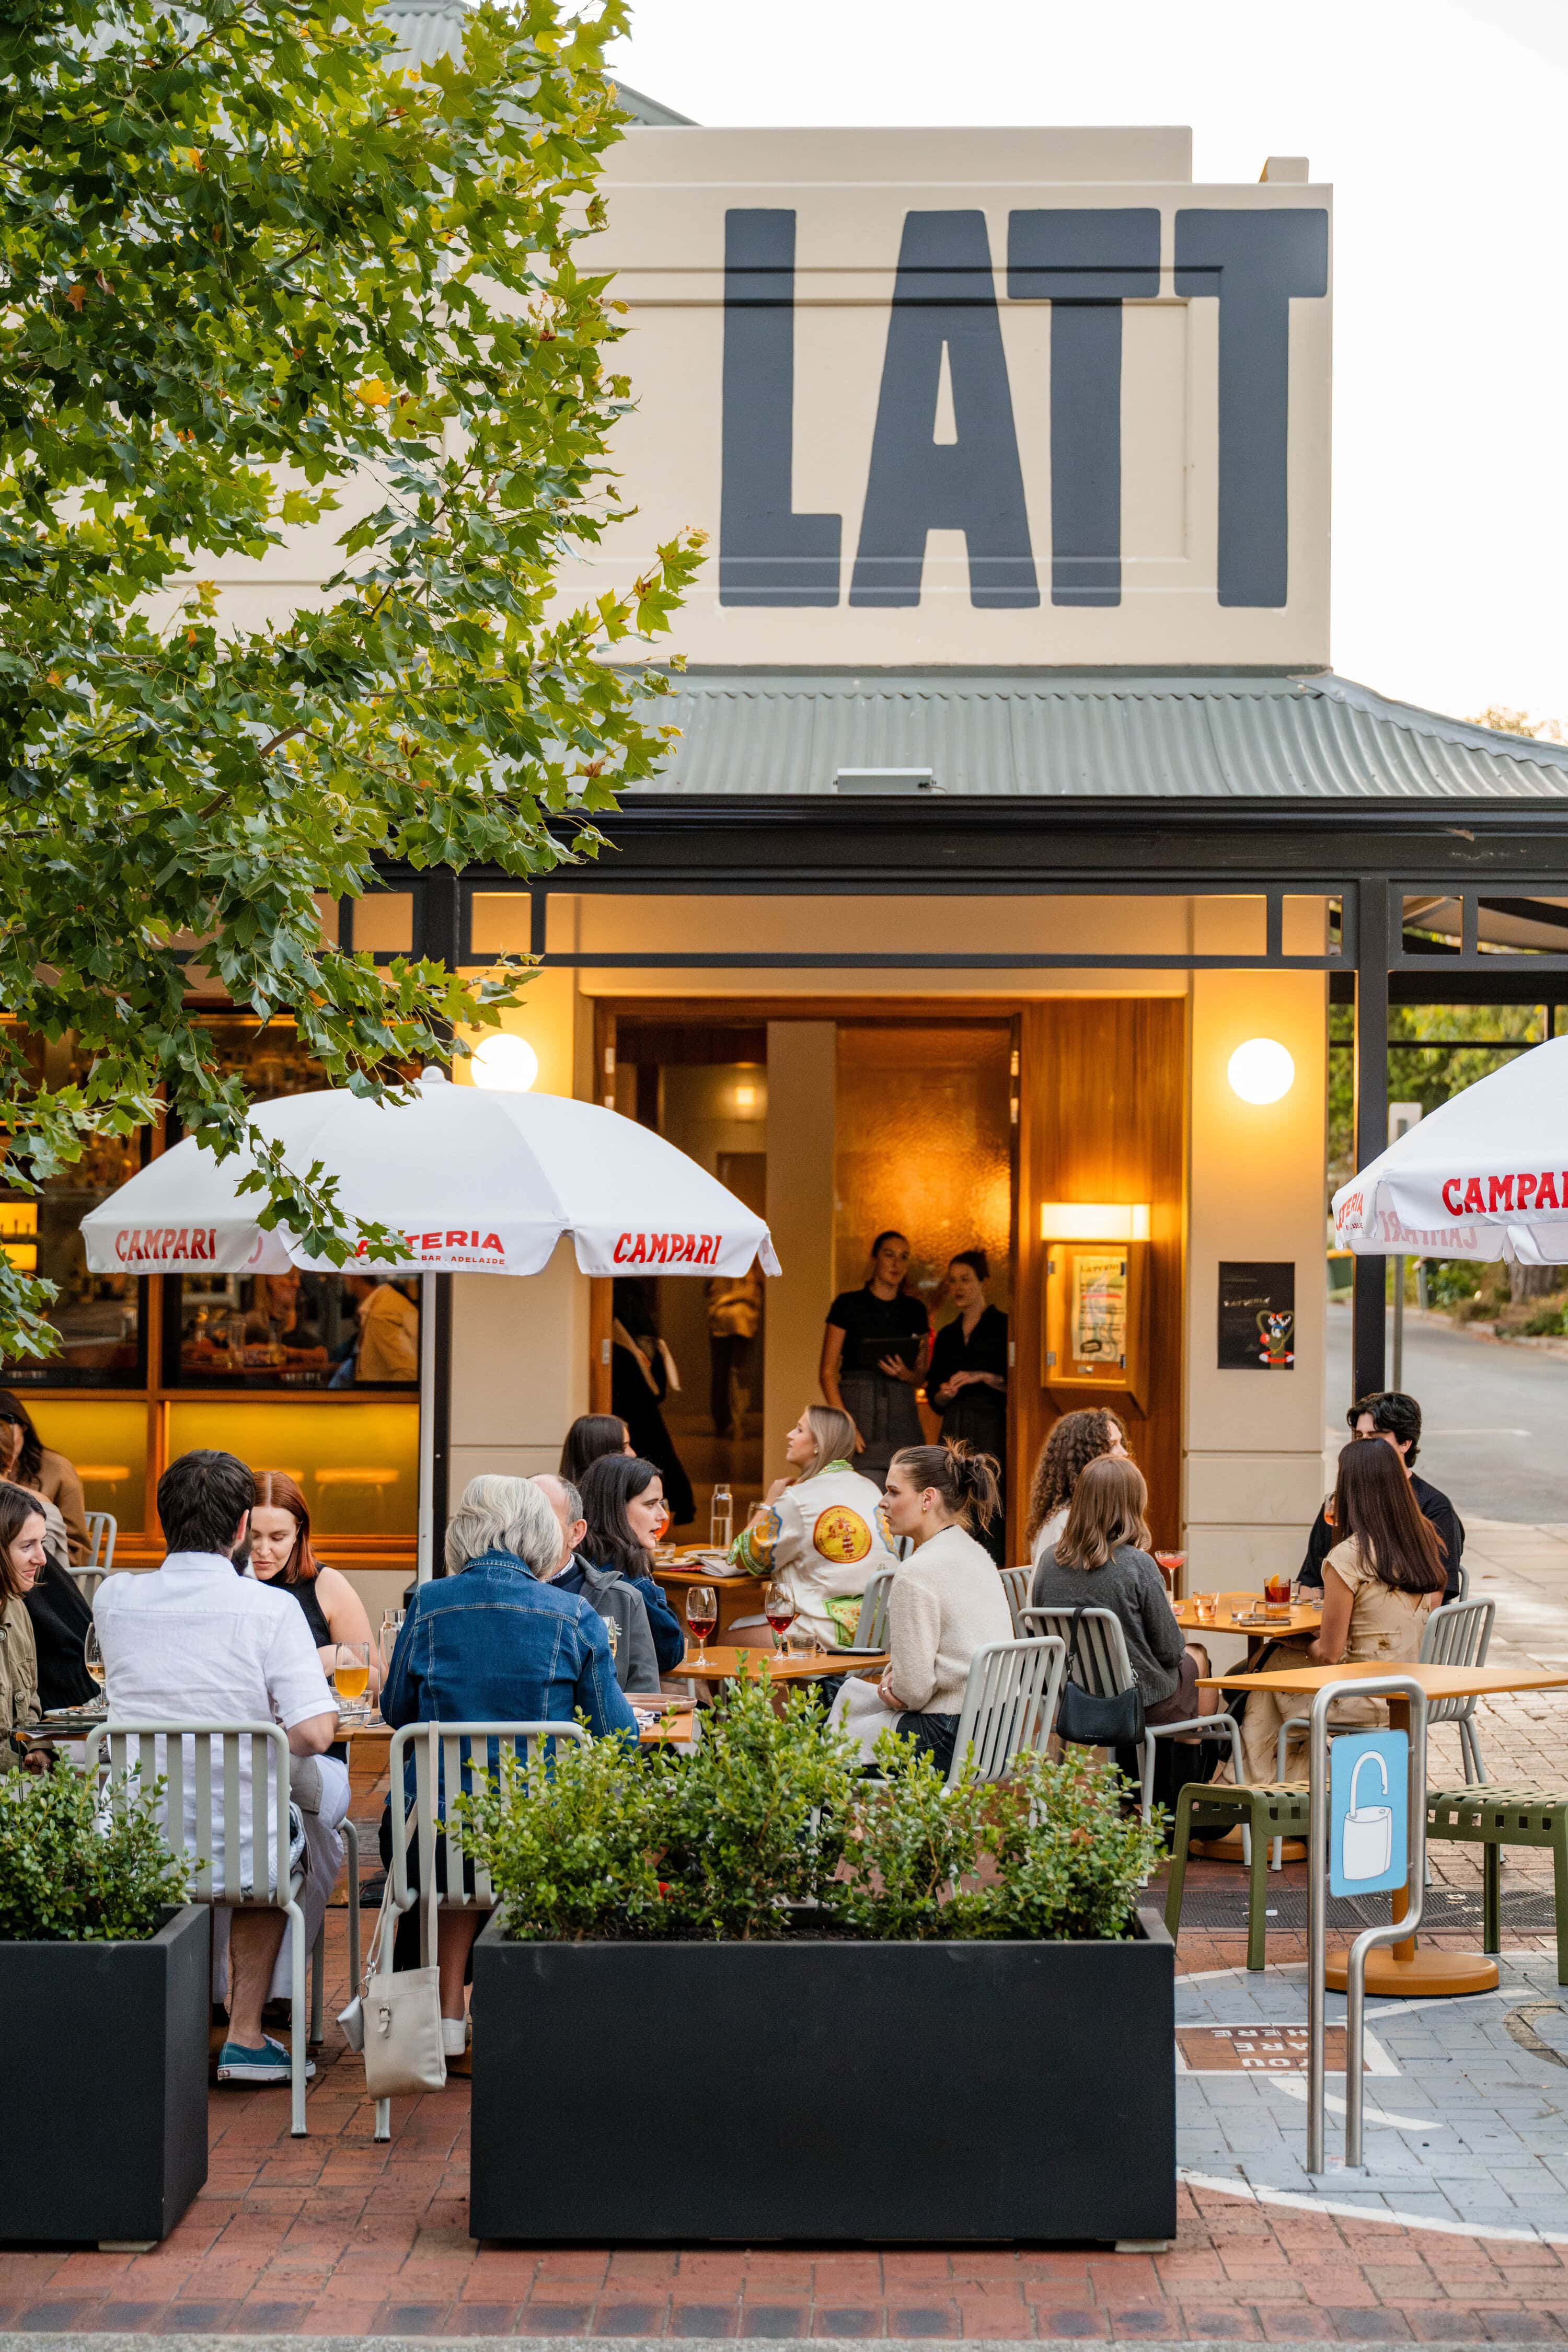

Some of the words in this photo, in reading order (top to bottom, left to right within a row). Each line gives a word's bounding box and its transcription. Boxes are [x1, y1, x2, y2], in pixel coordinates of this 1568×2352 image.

[719, 207, 1328, 608] LATT
[115, 1228, 217, 1262] CAMPARI
[613, 1232, 722, 1264] CAMPARI
[451, 1256, 505, 1264] ADELAIDE
[1210, 2029, 1309, 2037] HERE
[1234, 2042, 1309, 2051] ARE
